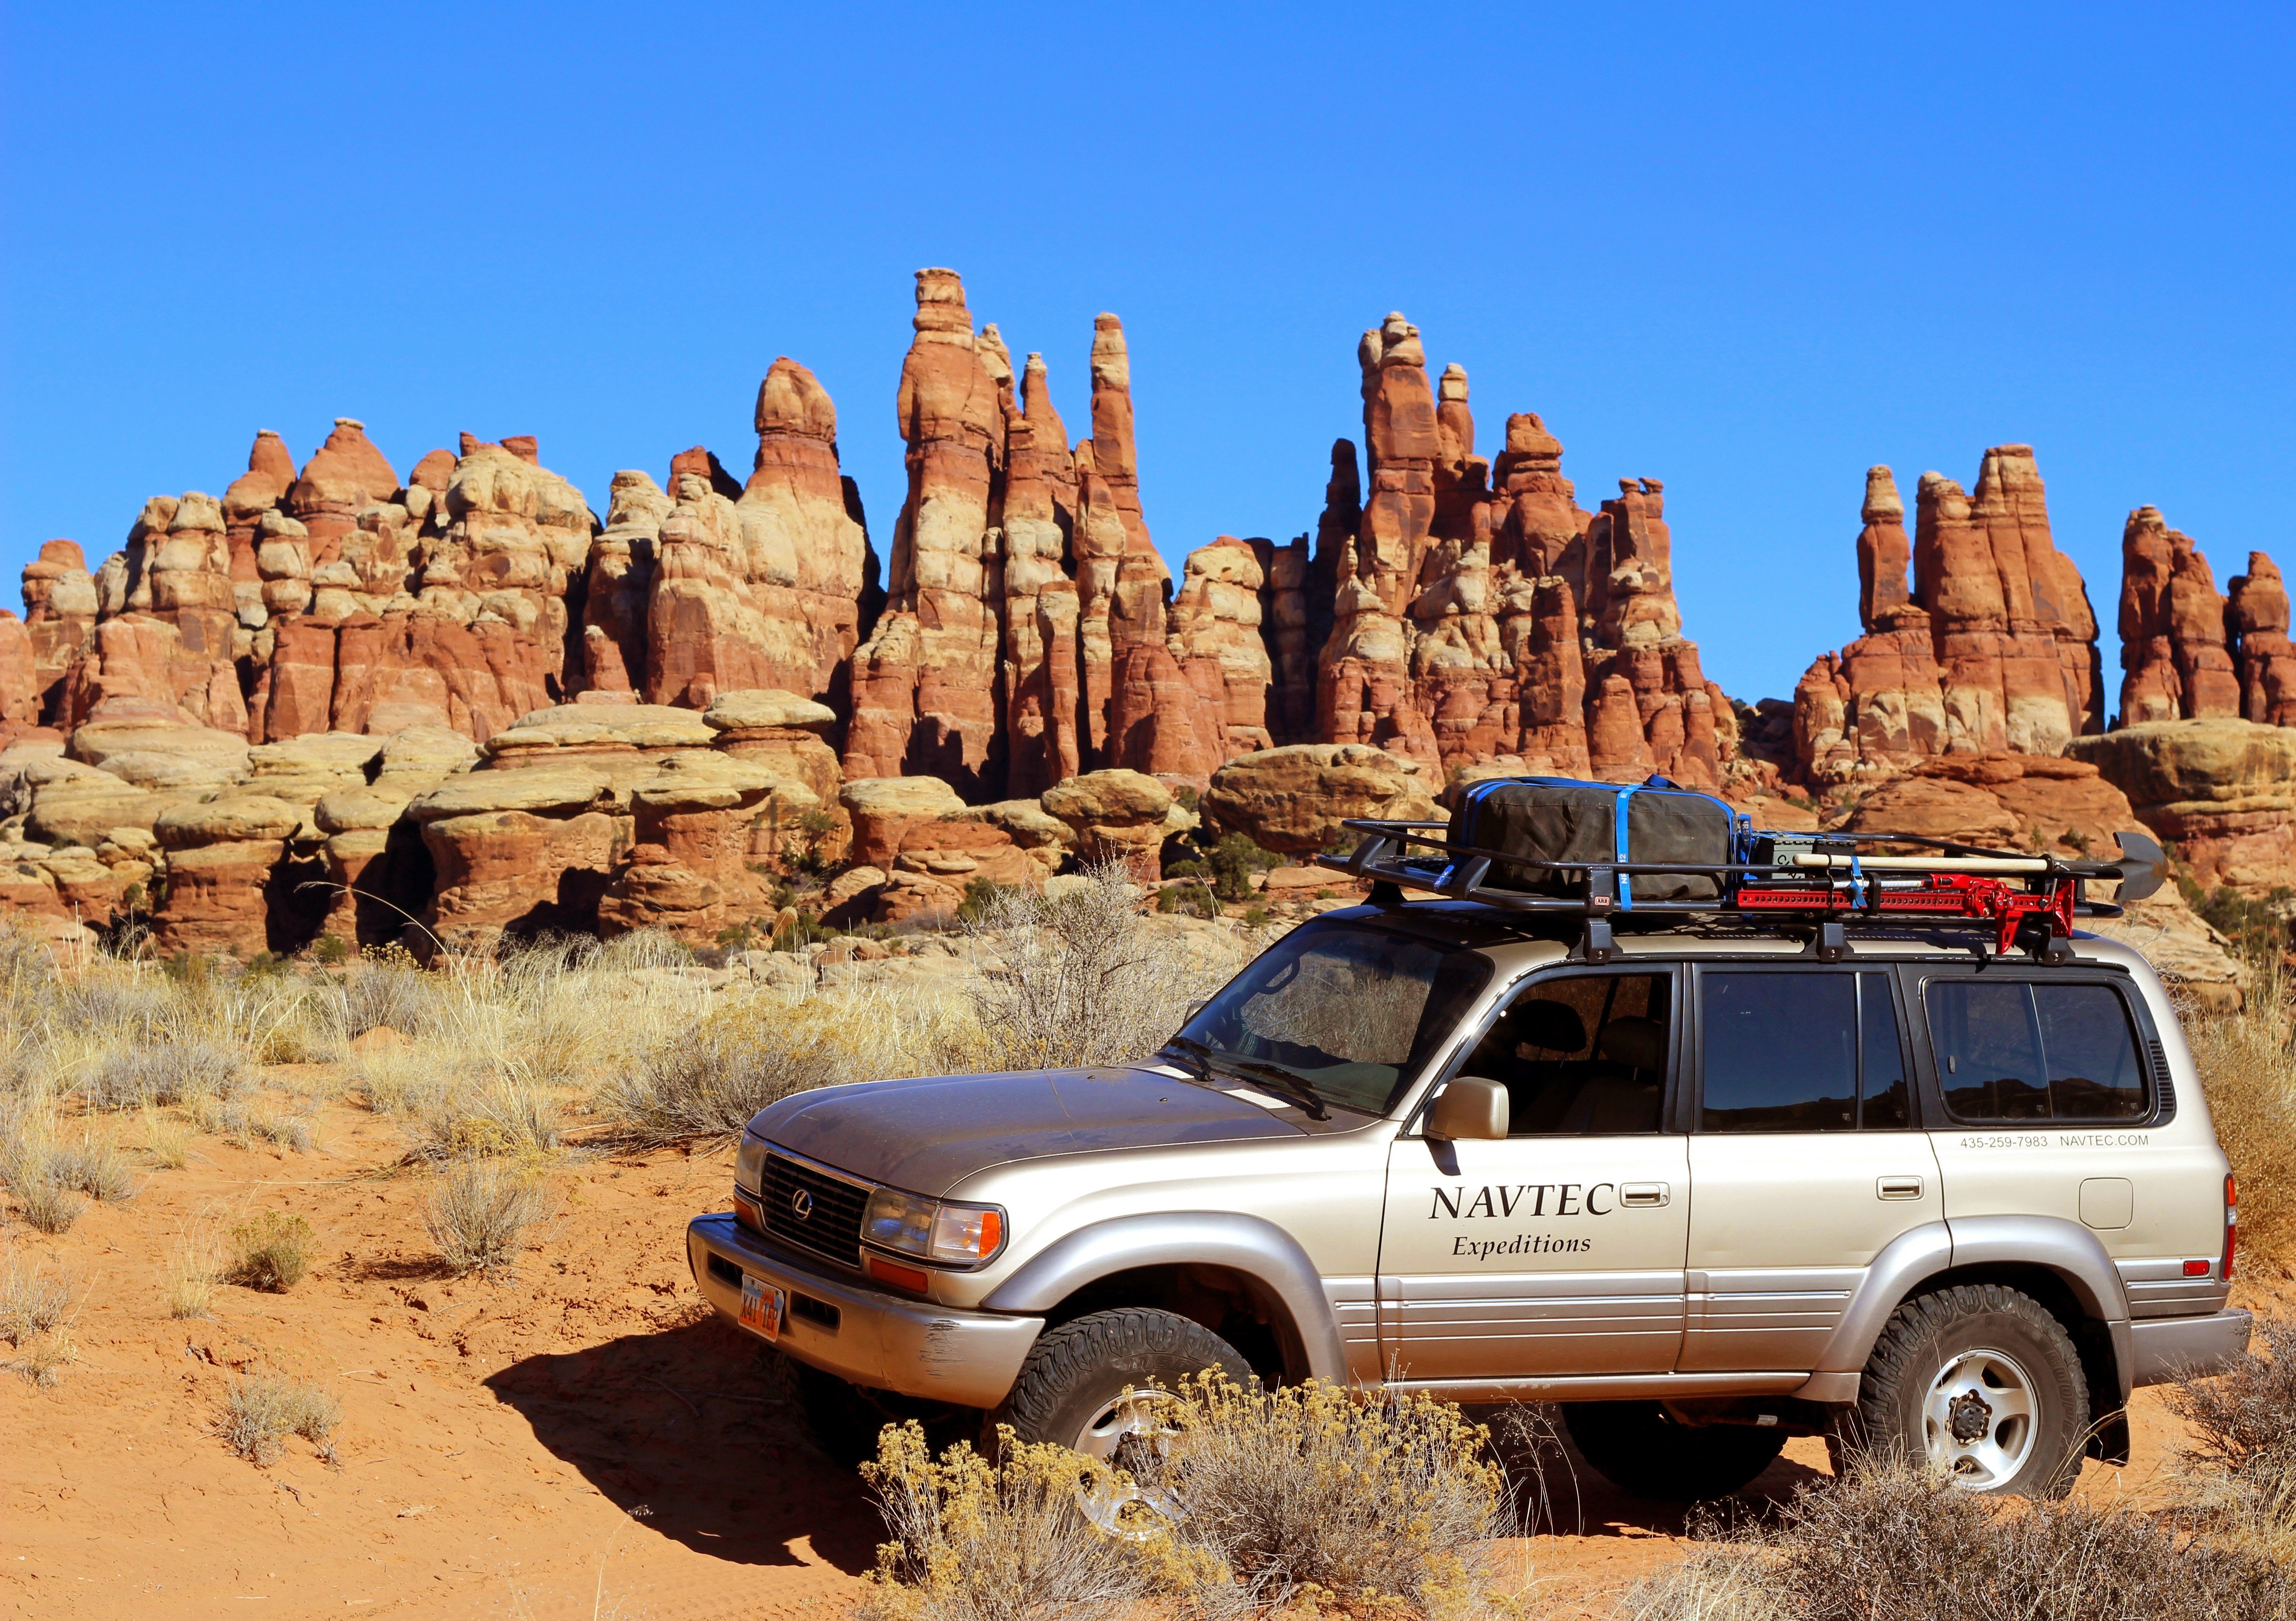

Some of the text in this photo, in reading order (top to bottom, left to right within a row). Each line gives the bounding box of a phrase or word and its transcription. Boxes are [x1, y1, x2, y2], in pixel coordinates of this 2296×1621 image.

[1961, 1135, 2148, 1148] 435-259-7983 NAVTEC.COM
[1428, 1183, 1614, 1219] NAVTEC
[1452, 1234, 1591, 1261] Expeditions
[758, 1284, 771, 1296] UTAH
[741, 1293, 756, 1323] X41
